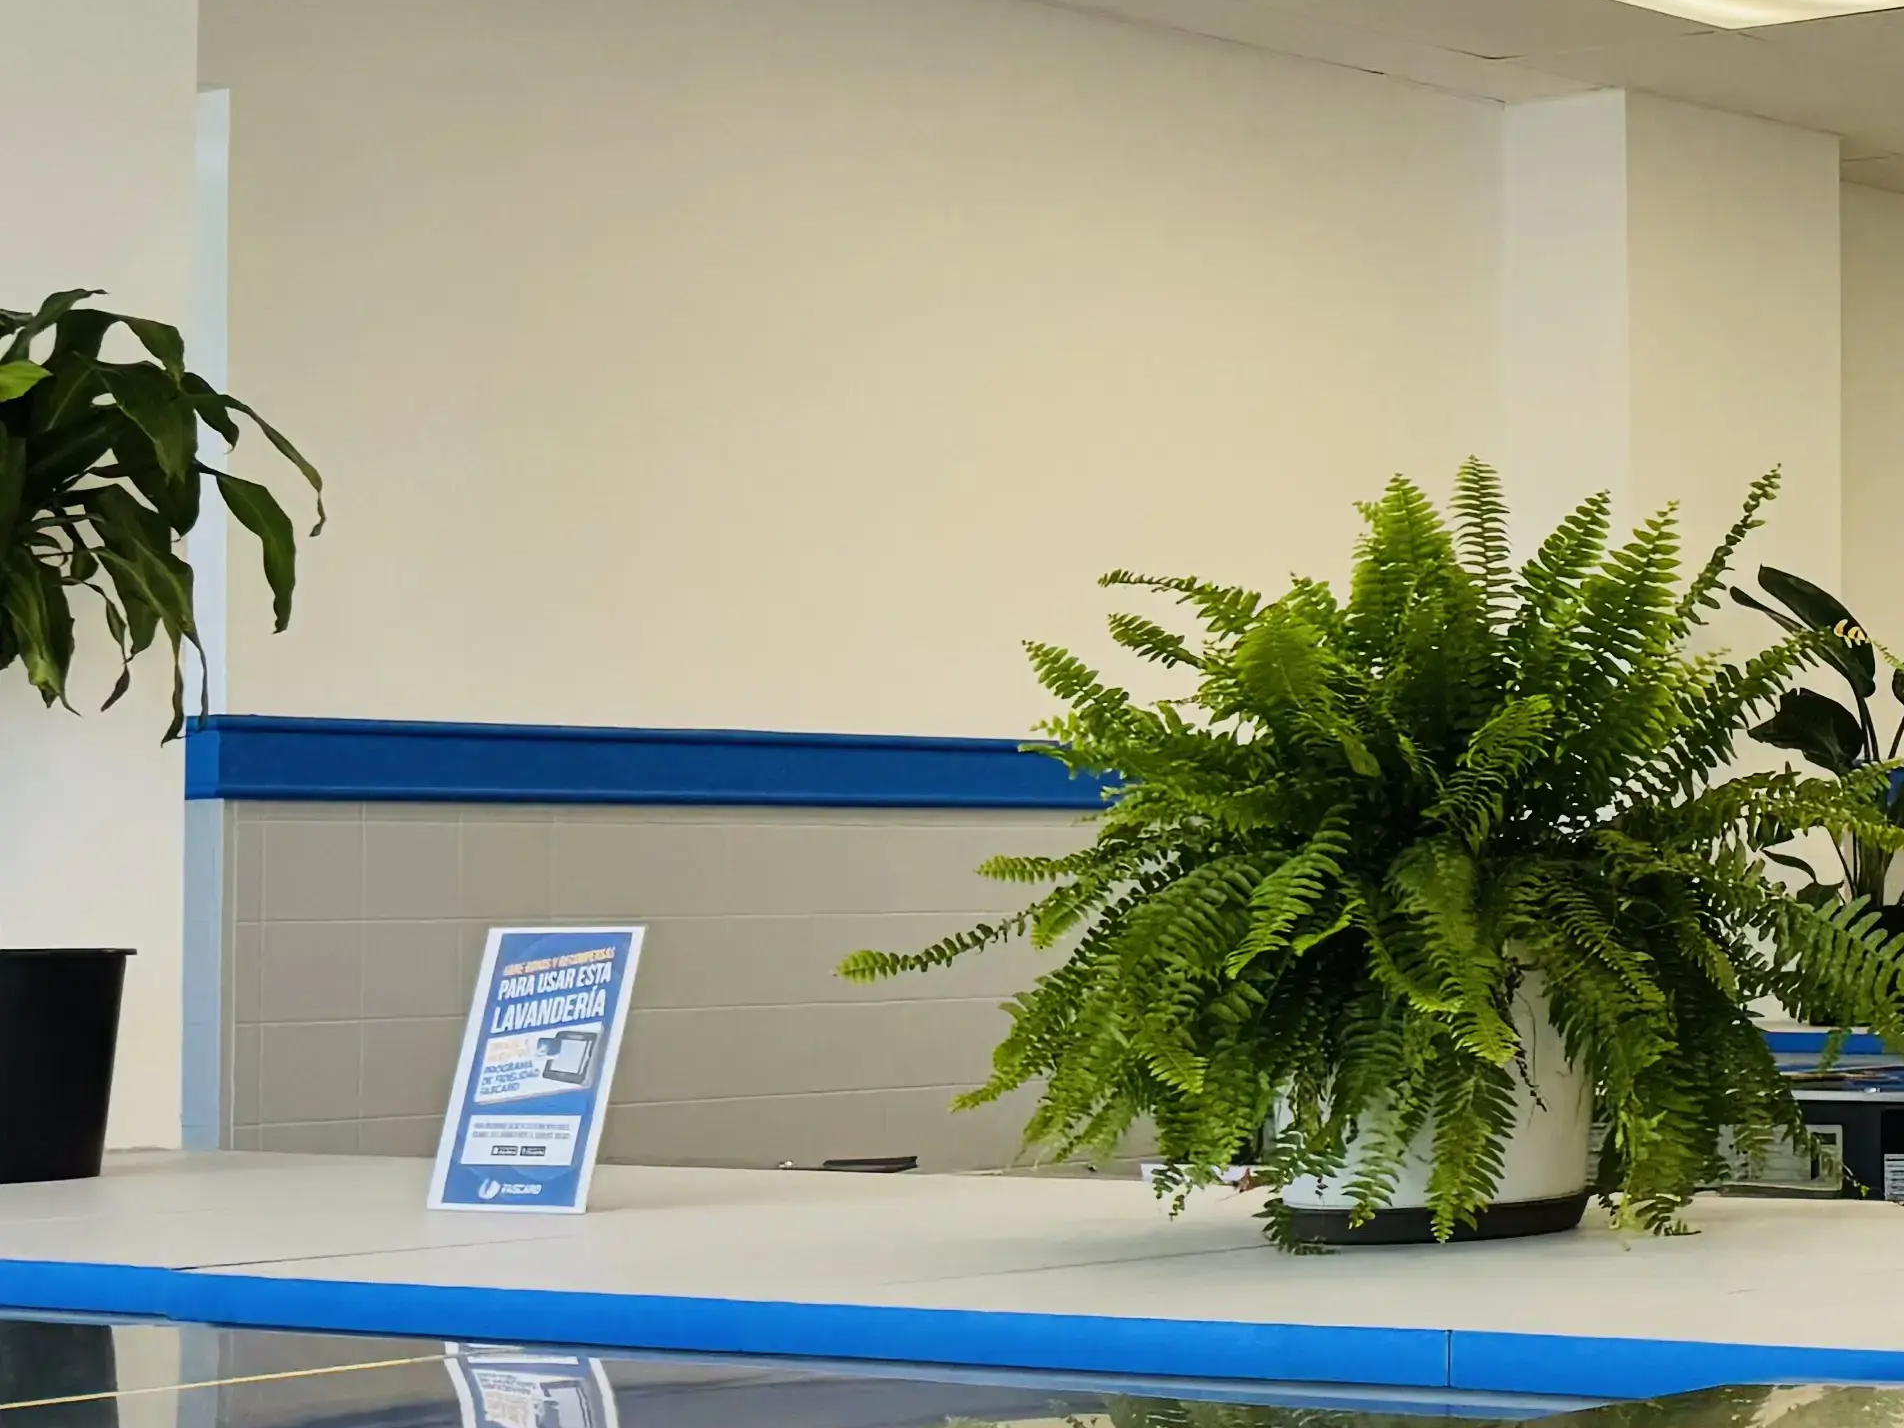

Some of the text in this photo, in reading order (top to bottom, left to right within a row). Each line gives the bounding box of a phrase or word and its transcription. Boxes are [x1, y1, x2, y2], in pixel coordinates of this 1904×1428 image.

[497, 974, 535, 1000] PARA
[537, 968, 576, 994] USAR
[576, 961, 613, 988] ESTA
[490, 985, 606, 1034] LAVANDERÍA
